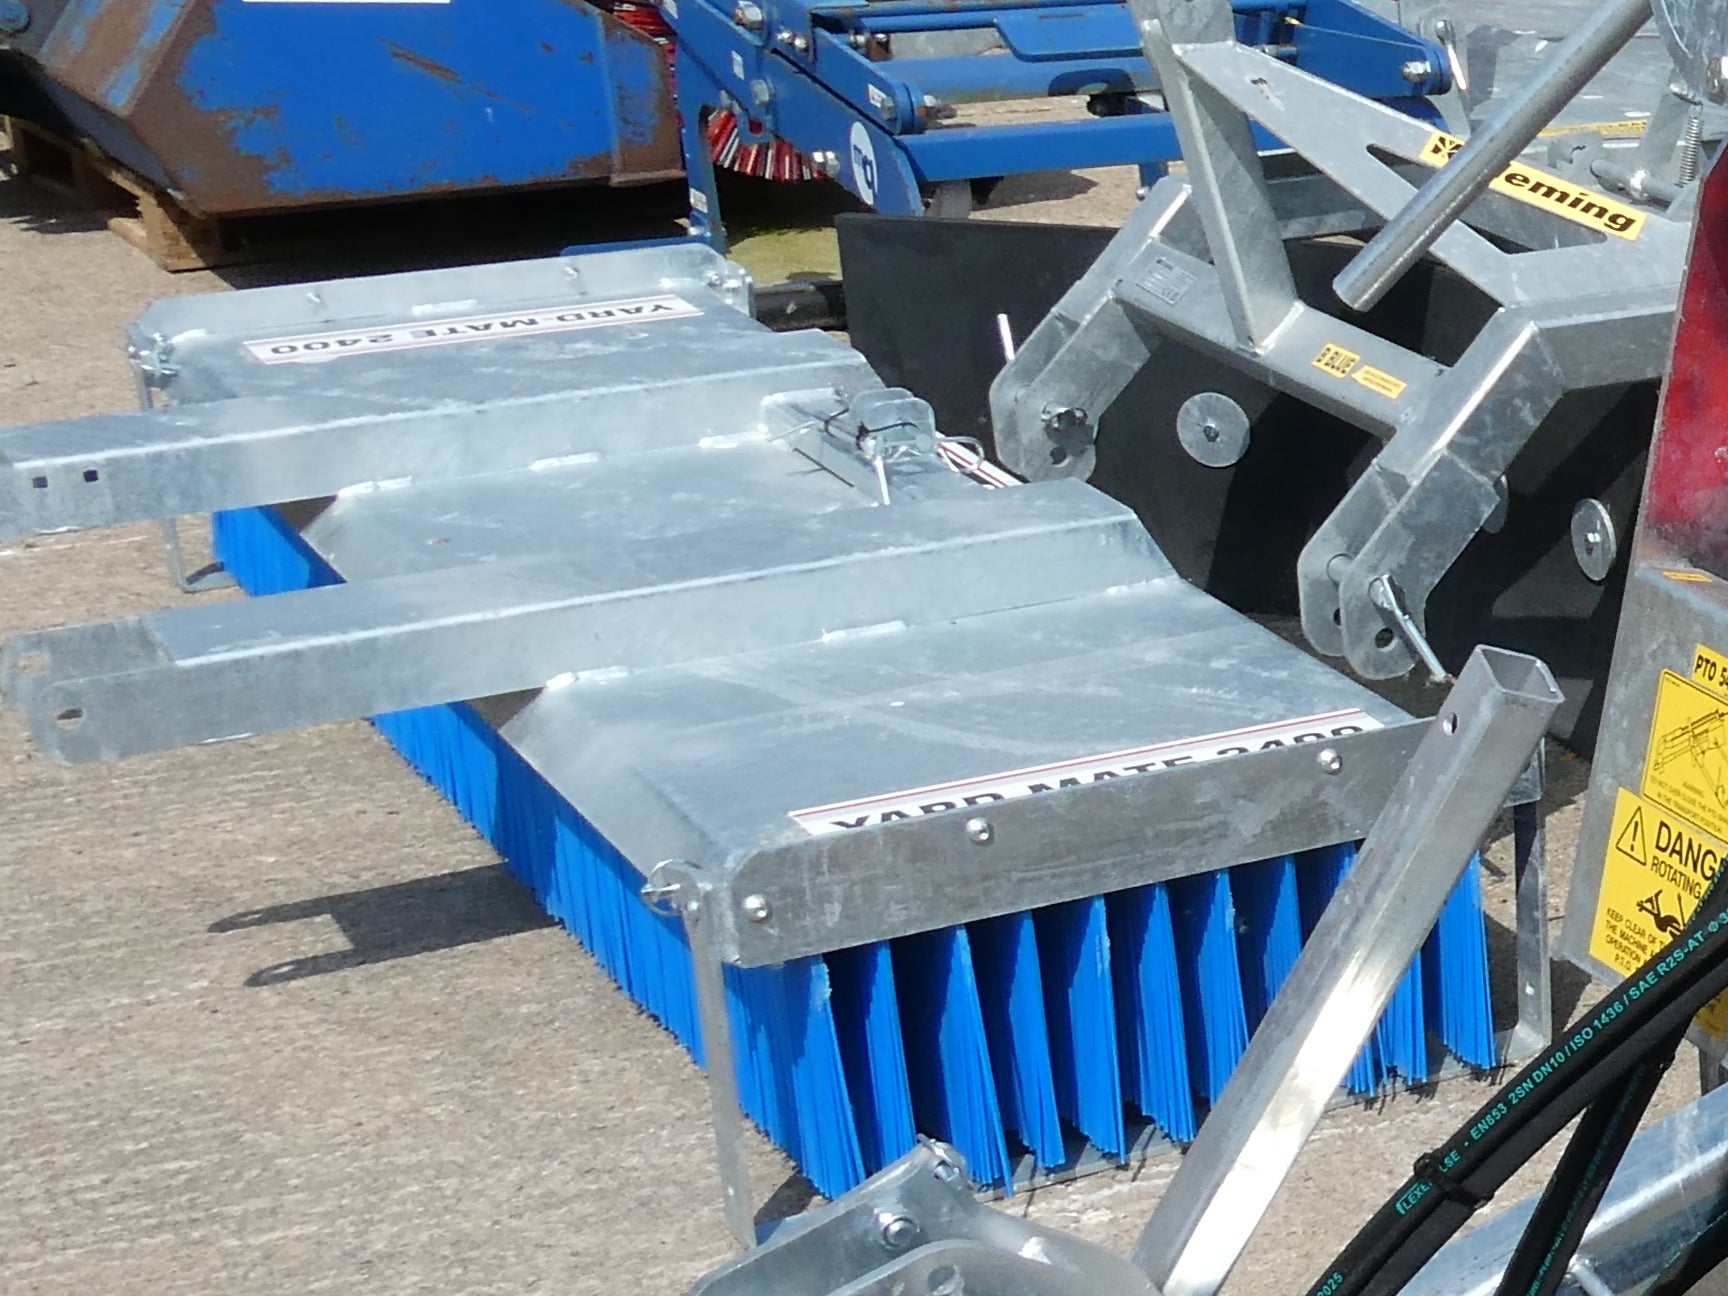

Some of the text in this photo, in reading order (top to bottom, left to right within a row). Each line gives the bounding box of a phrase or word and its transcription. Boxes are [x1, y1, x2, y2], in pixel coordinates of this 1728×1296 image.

[1503, 170, 1637, 233] eming
[270, 332, 392, 356] 2400
[1694, 654, 1717, 682] PTO
[829, 754, 1201, 829] YARDMATE
[1655, 820, 1722, 882] DANG
[1651, 855, 1703, 900] ROTATING
[1605, 919, 1648, 955] THE MACHINE
[1606, 907, 1647, 937] KEEP CLEAR
[1605, 934, 1641, 964] OPERATION
[1469, 1103, 1508, 1141] EN853
[1508, 1078, 1534, 1105] 2SN
[1532, 1050, 1566, 1084] DN10
[1570, 1027, 1594, 1051] ISO
[1593, 1000, 1624, 1030] 1436
[1629, 973, 1658, 1001] SAE
[1657, 930, 1705, 977] R2S-AT
